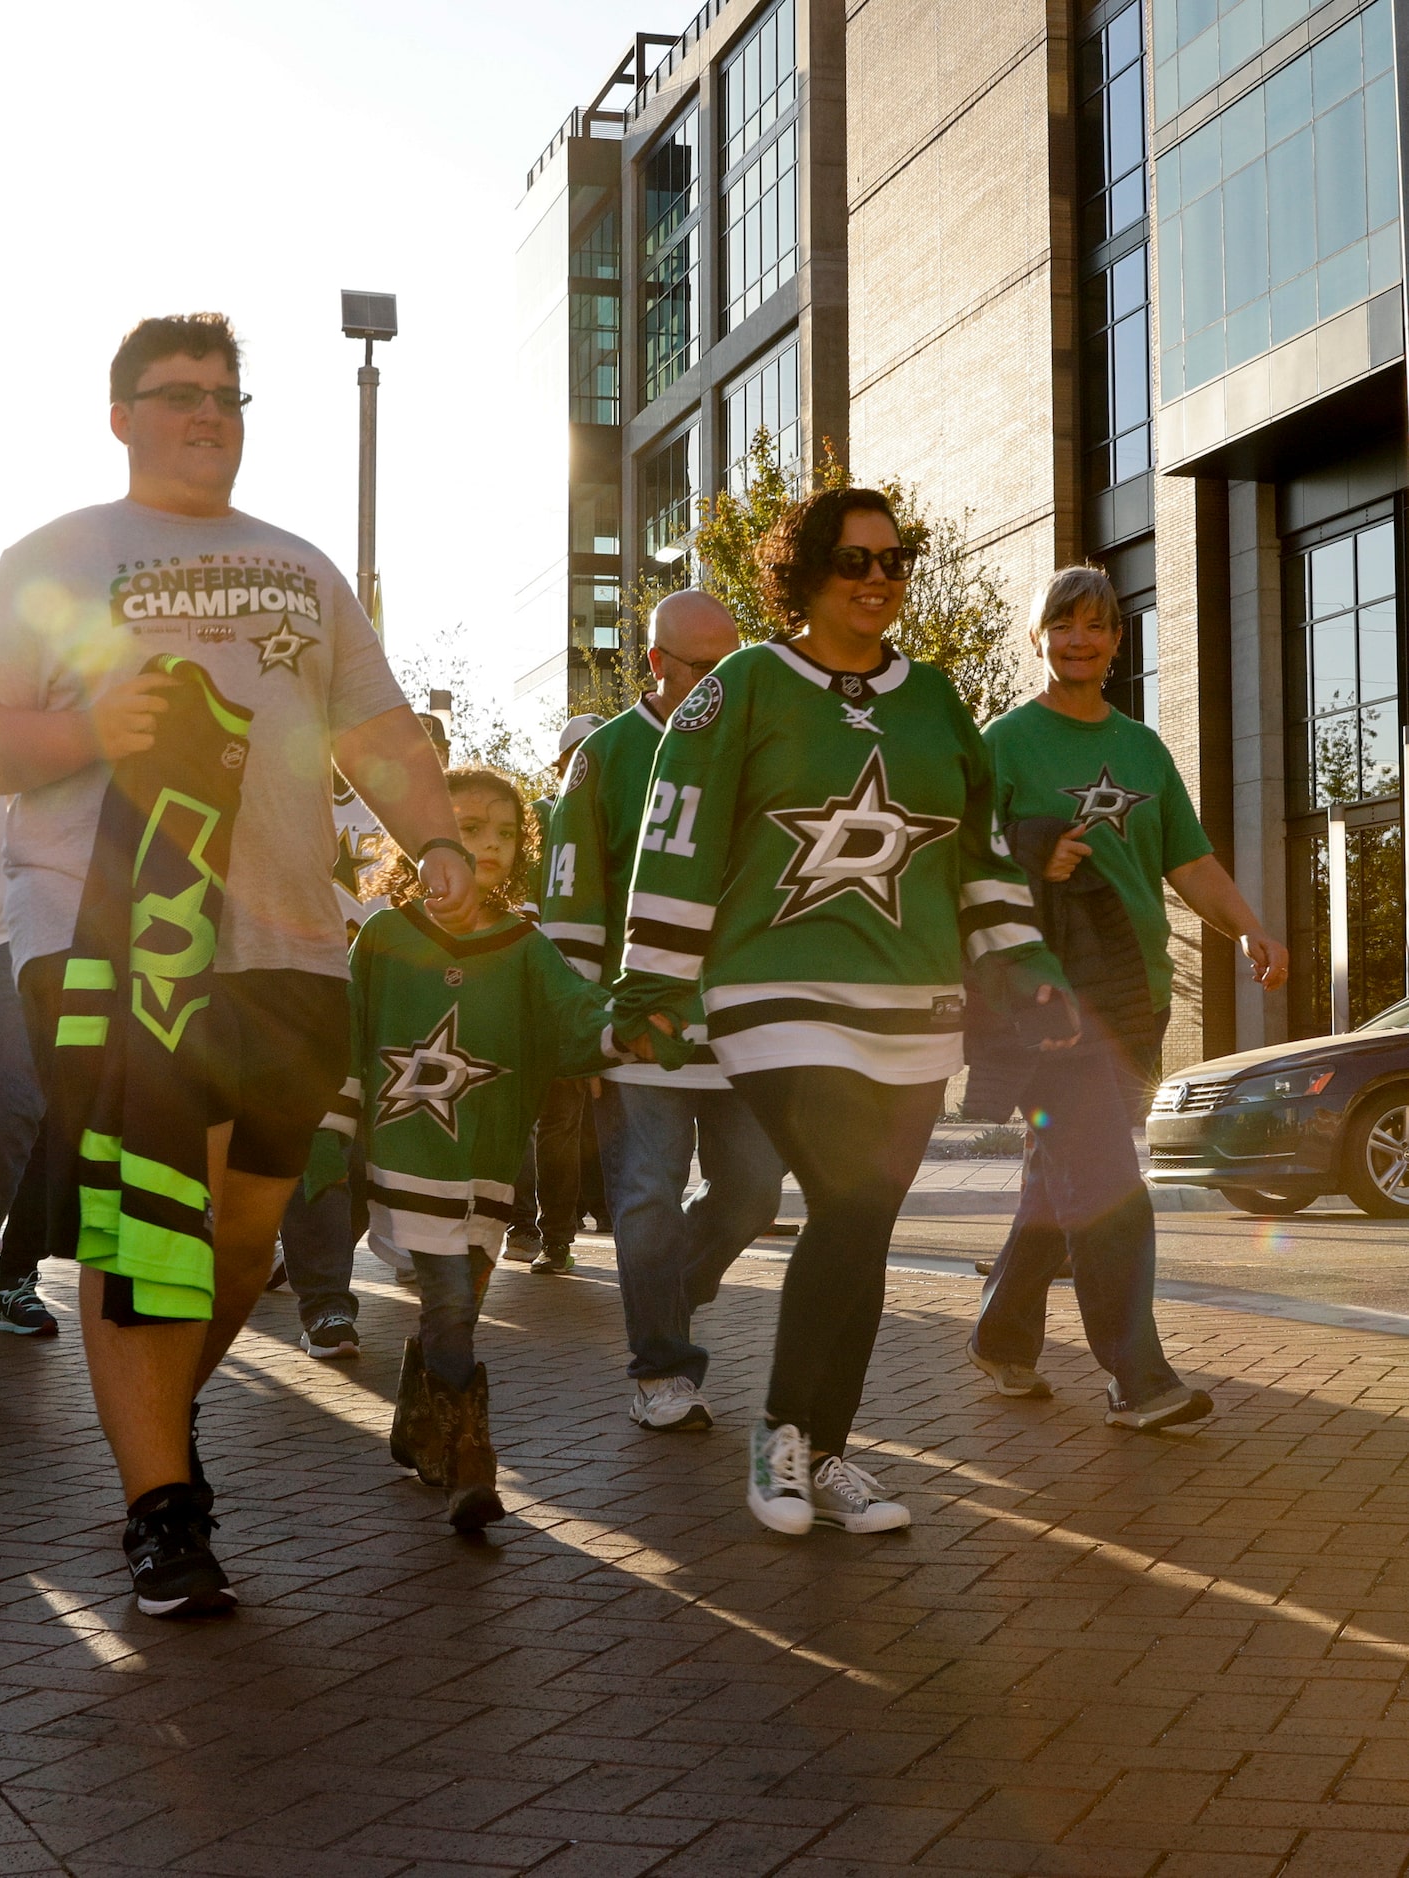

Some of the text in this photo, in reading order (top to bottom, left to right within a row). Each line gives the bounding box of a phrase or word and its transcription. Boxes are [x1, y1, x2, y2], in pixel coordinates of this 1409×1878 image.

[117, 554, 307, 574] 2020 WESTERN
[110, 566, 318, 598] CONFERENCE
[123, 586, 319, 620] CHAMPIONS
[641, 779, 702, 858] 21
